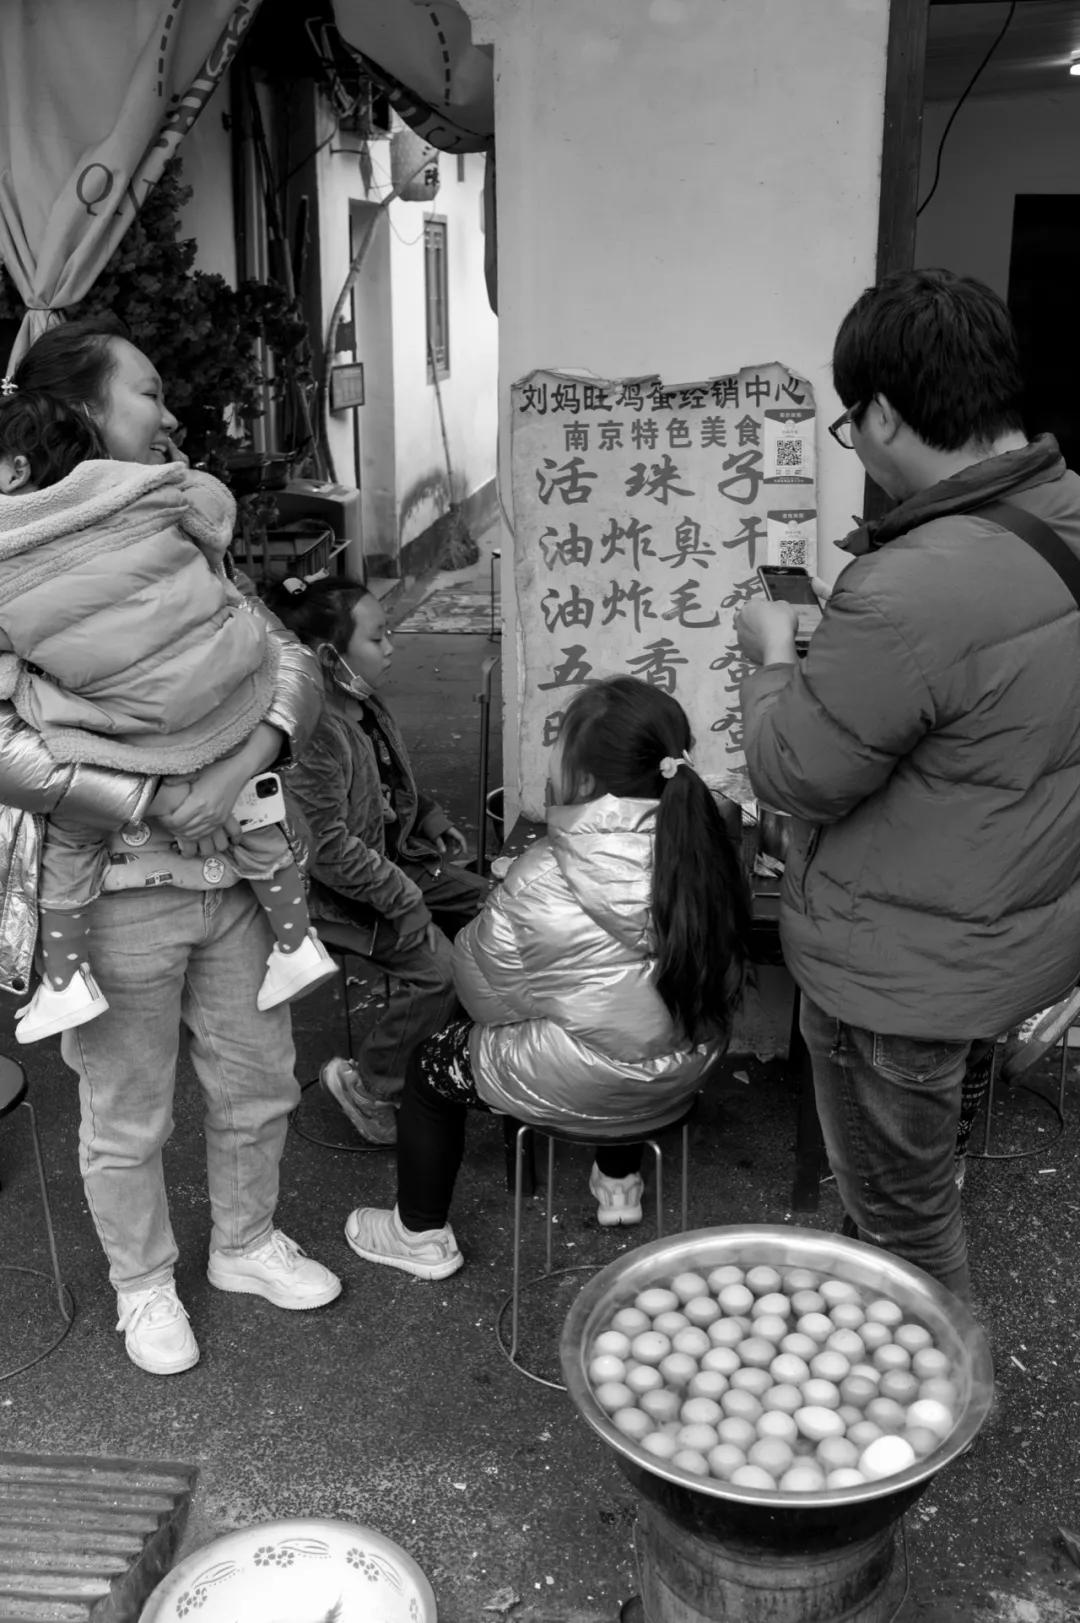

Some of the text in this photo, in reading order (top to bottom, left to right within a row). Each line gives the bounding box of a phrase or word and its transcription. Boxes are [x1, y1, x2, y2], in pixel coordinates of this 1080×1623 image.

[563, 414, 762, 451] 南京特色美食
[536, 450, 764, 505] 活珠子
[539, 516, 768, 571] 油炸臭干
